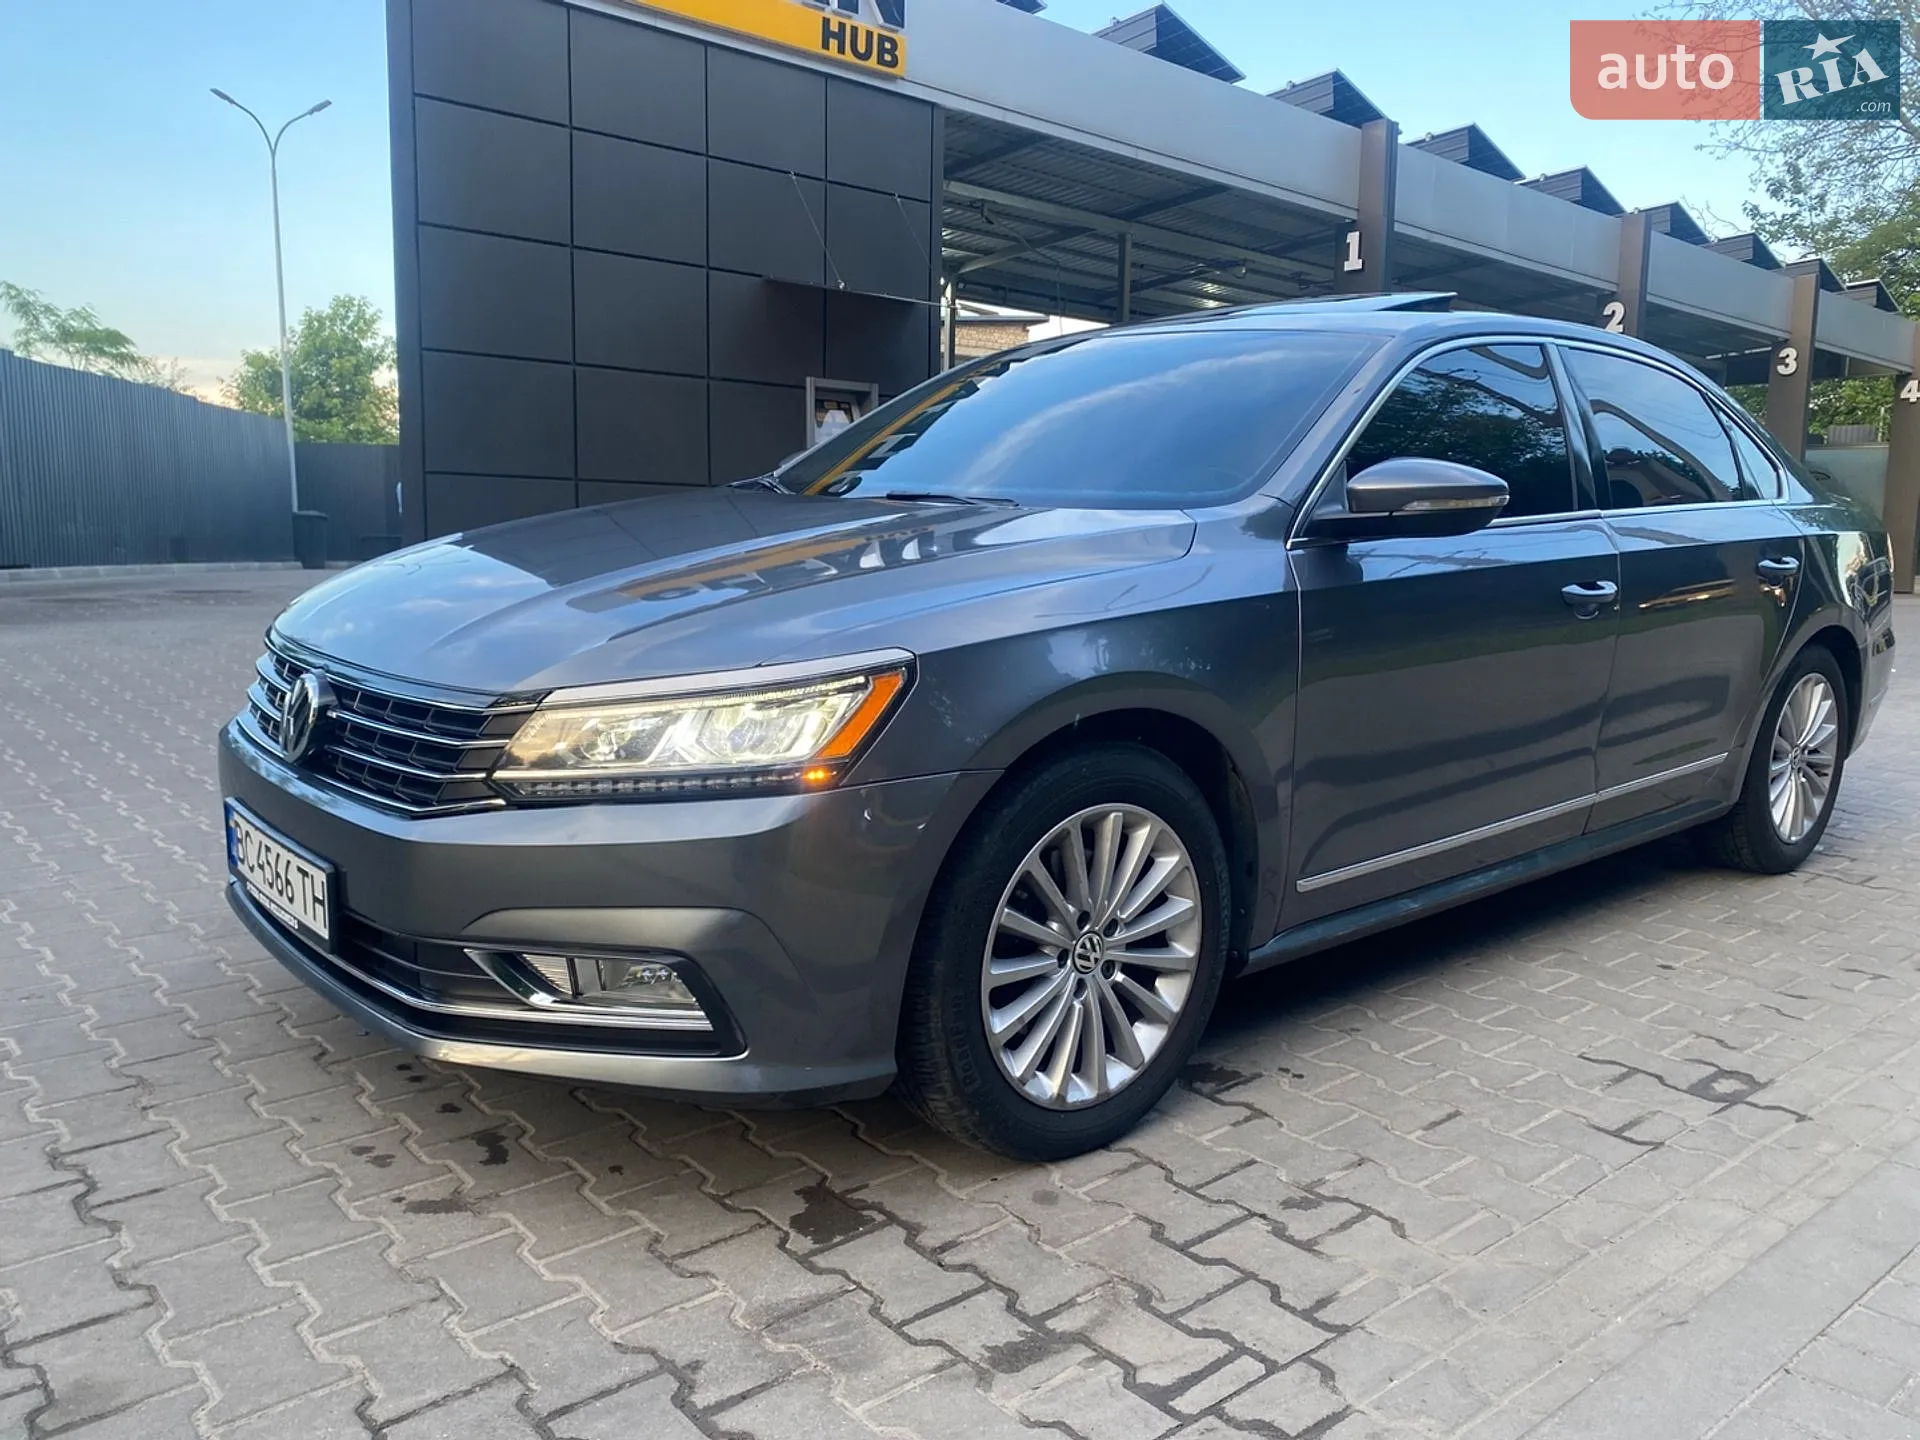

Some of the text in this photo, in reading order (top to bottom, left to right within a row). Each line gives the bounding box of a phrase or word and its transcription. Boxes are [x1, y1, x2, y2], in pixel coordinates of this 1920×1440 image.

[821, 16, 899, 68] HUB
[1344, 231, 1363, 271] 1
[1603, 301, 1625, 333] 2
[1777, 347, 1798, 375] 3
[1900, 379, 1920, 402] 4
